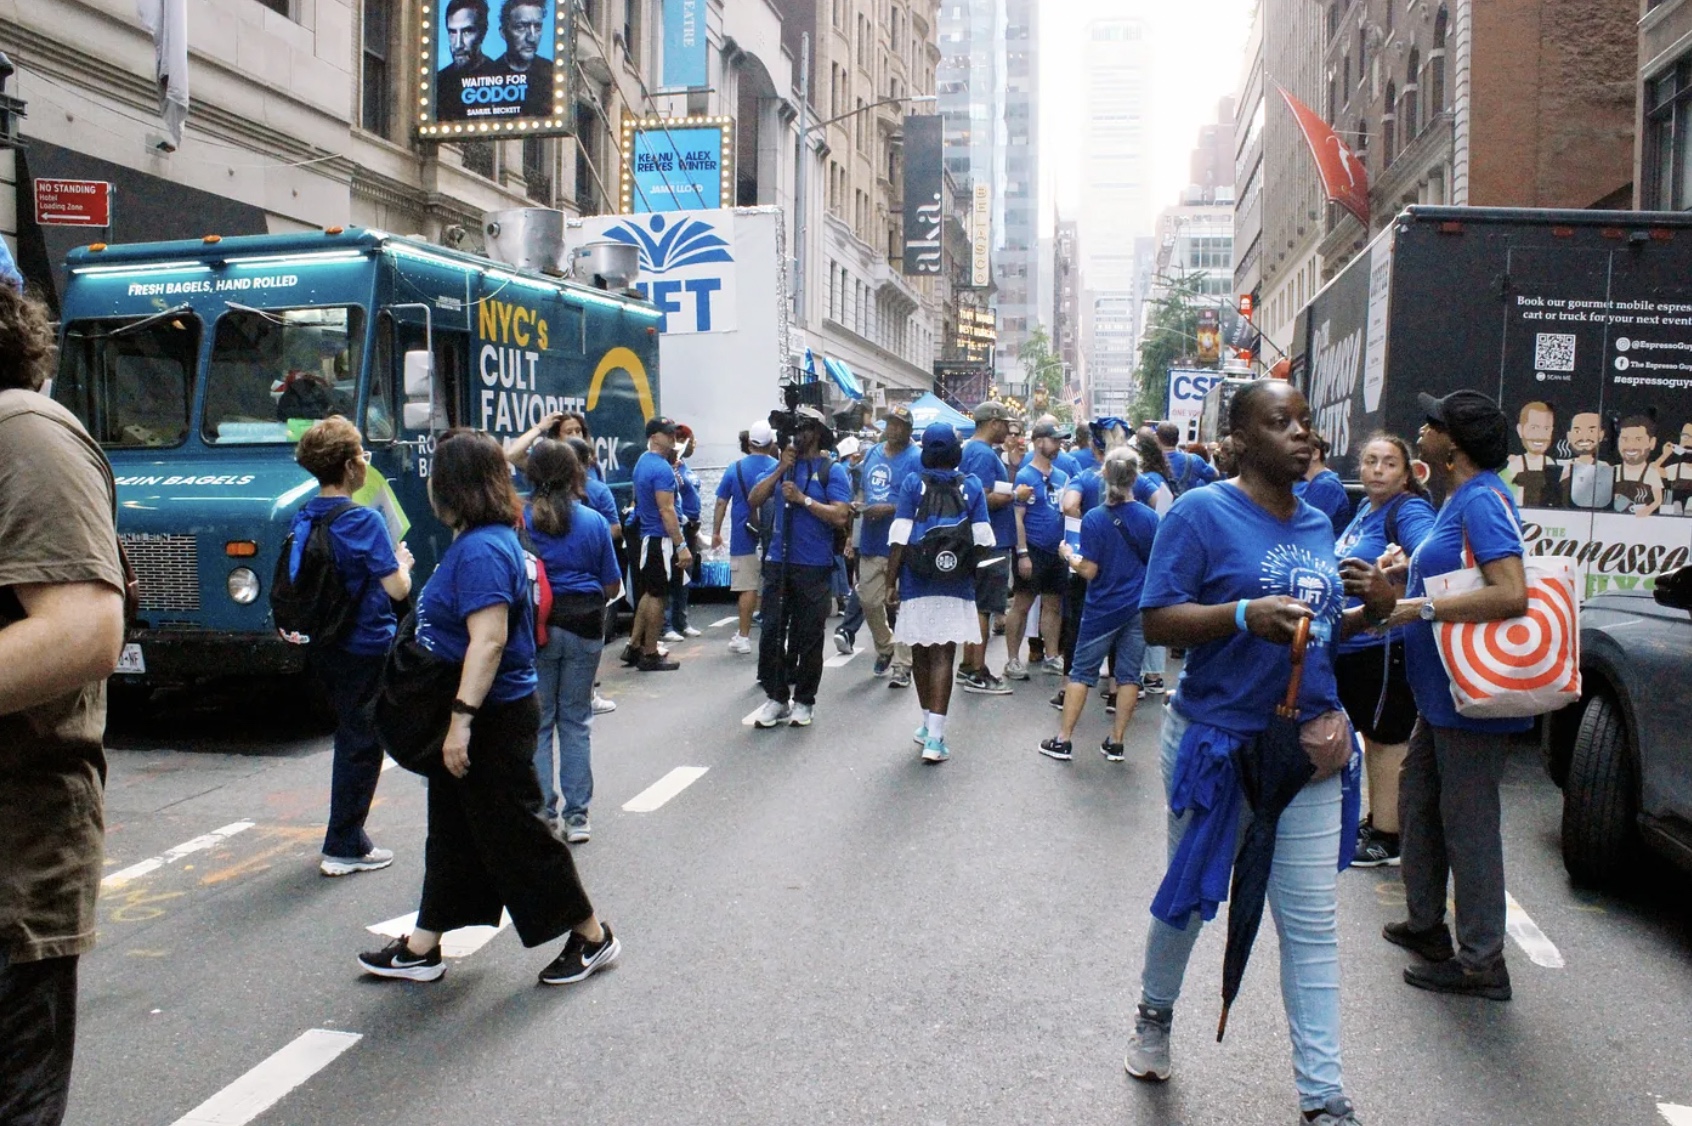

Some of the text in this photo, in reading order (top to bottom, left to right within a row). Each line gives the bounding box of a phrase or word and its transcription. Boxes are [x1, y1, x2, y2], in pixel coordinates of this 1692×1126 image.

[462, 74, 527, 88] WAITING FOR
[461, 85, 528, 104] GODOT
[467, 105, 521, 116] SAMUEL BECKETT
[685, 150, 712, 161] ALEX
[40, 183, 96, 194] NO STANDING
[40, 203, 83, 211] Loading Zone
[975, 185, 987, 284] BELASCO
[128, 275, 298, 296] FRESH BAGELS, HAND ROLLED
[1517, 295, 1545, 306] Book
[1547, 299, 1565, 307] our
[1567, 299, 1613, 310] gourmet
[1616, 300, 1654, 310] mobile
[479, 297, 549, 350] NYC's
[1523, 310, 1692, 325] cart or truck for your next event
[479, 344, 539, 391] CULT
[1630, 360, 1644, 368] The
[1646, 362, 1678, 370] Espresso
[163, 475, 256, 485] BAGELS
[1545, 527, 1566, 537] THE
[1299, 588, 1322, 605] UFT
